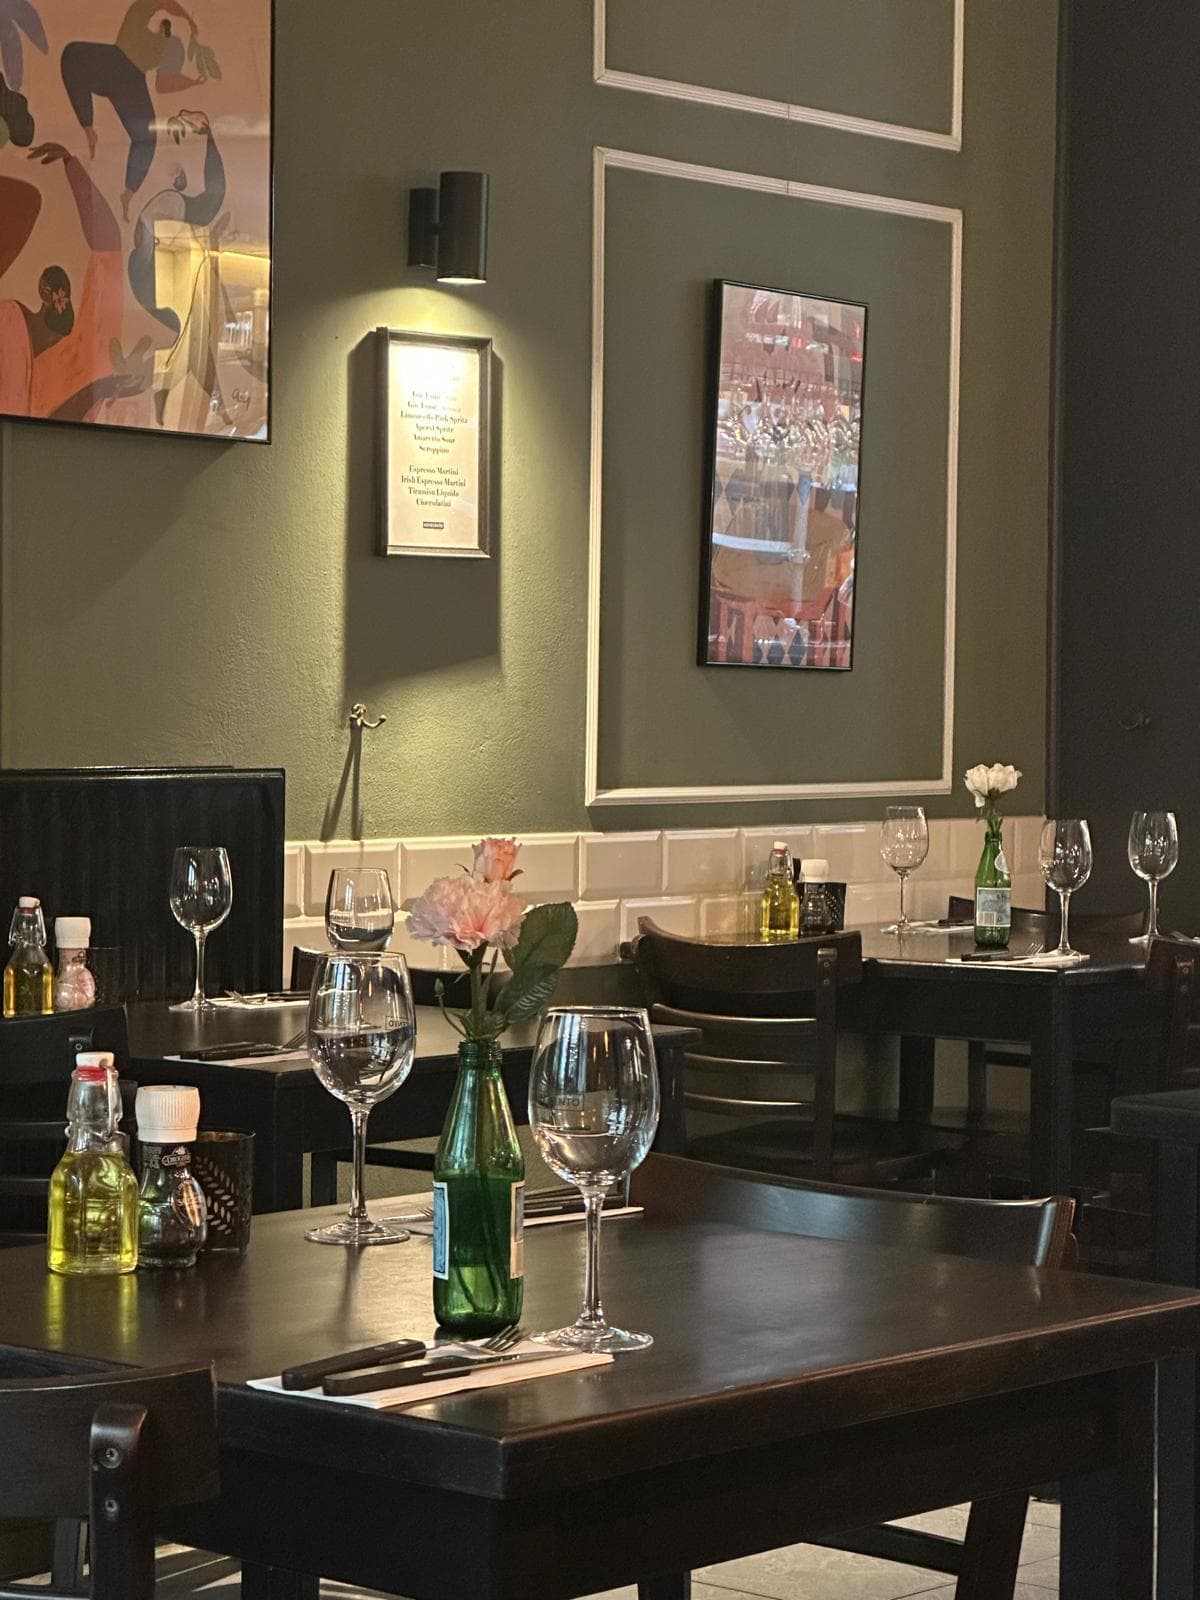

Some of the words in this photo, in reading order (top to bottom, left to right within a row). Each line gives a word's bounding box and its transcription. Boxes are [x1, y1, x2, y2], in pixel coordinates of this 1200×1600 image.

[409, 464, 436, 474] Espresso
[437, 467, 459, 476] Martini
[401, 475, 416, 484] Irish
[416, 476, 444, 486] Espresso
[444, 478, 466, 487] Martini
